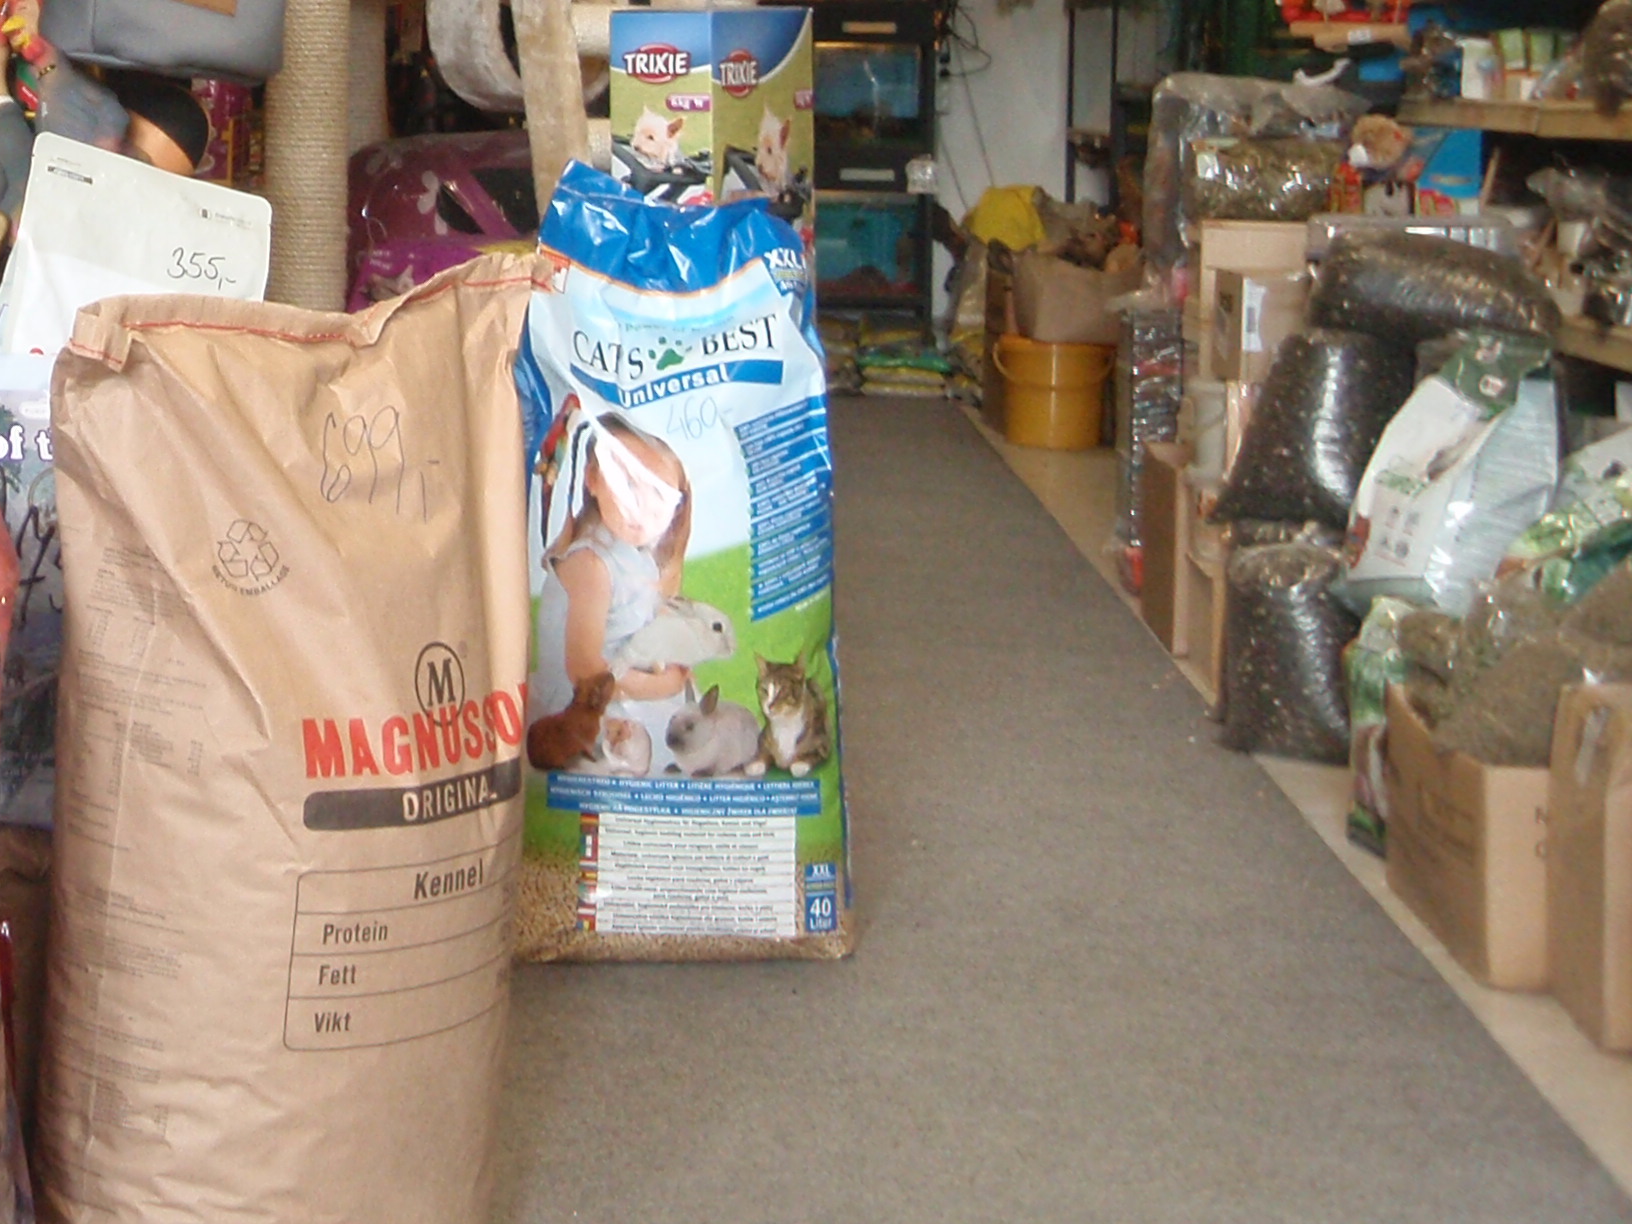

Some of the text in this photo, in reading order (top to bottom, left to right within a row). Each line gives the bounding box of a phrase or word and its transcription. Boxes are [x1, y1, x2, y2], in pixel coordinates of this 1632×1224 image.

[623, 52, 689, 75] TRIXIE
[719, 60, 759, 86] TRIXIE
[167, 247, 237, 290] 355,-
[700, 313, 778, 357] BEST
[618, 362, 731, 409] Universal
[427, 658, 457, 707] M
[413, 858, 484, 900] Kennel
[811, 864, 831, 877] XXL
[809, 896, 833, 918] 40
[322, 920, 389, 945] Protein
[318, 964, 357, 986] Fett
[313, 1012, 352, 1033] Vikt
